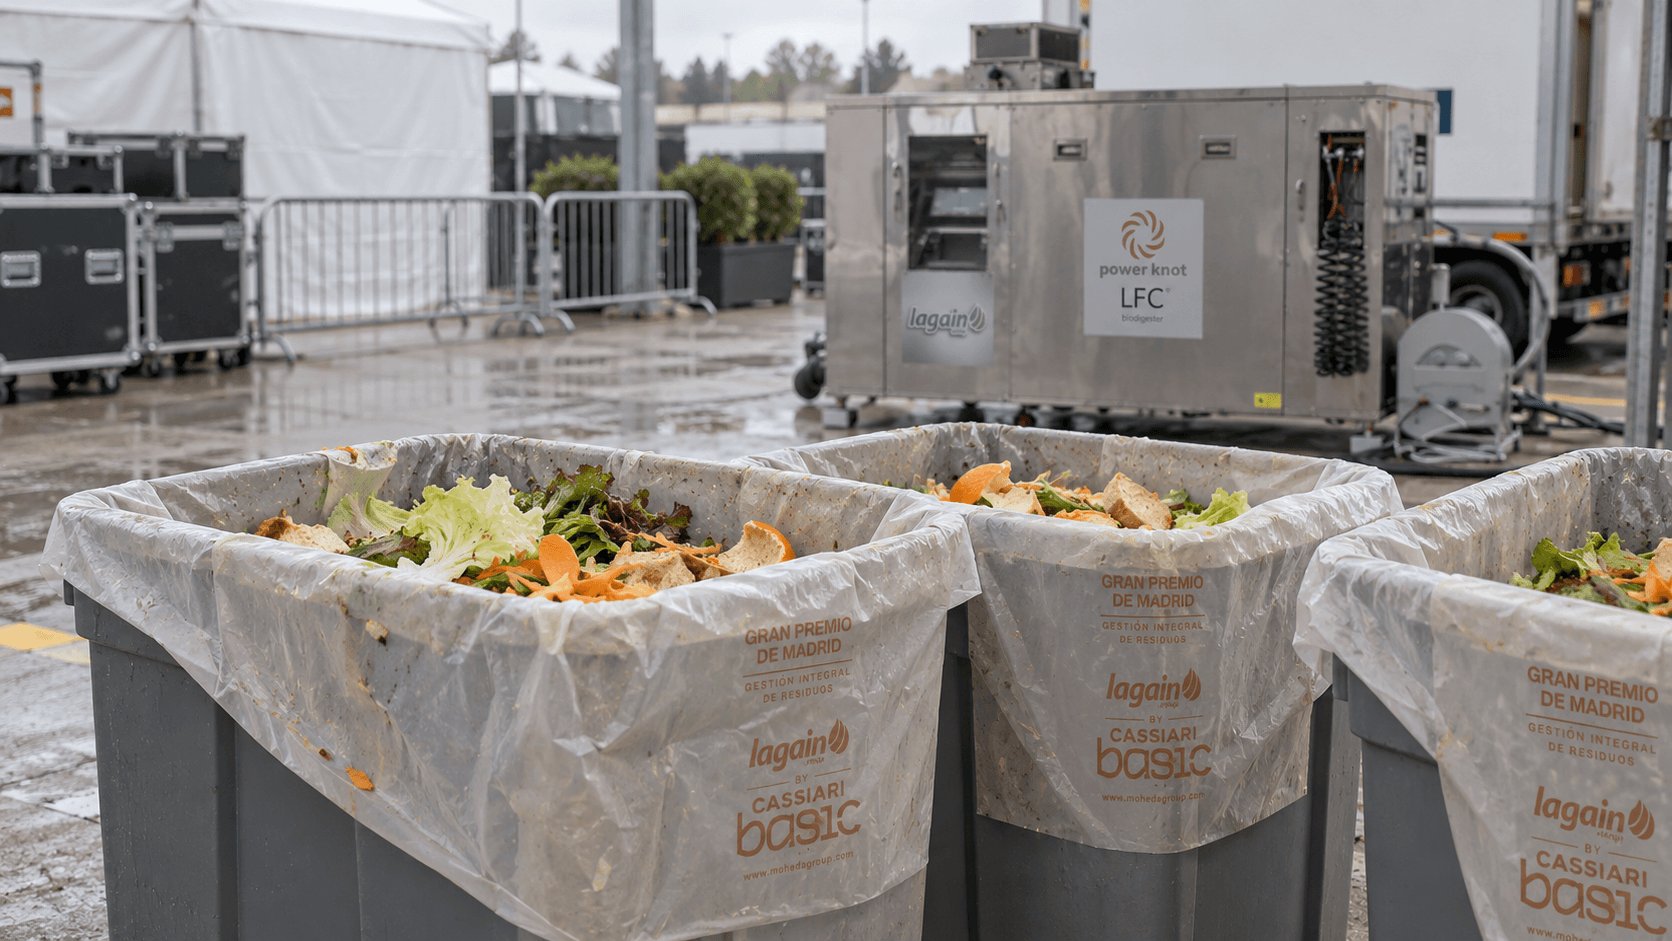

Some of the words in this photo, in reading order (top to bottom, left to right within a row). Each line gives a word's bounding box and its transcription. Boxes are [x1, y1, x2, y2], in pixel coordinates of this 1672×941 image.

[1099, 265, 1148, 278] power
[1151, 262, 1187, 276] knot
[909, 307, 968, 332] lagain
[1121, 314, 1164, 324] biodigester
[1101, 574, 1144, 589] GRAN
[1148, 575, 1204, 590] PREMIO
[1112, 593, 1133, 607] DE
[1137, 594, 1195, 608] MADRID
[745, 625, 790, 645] GRAN
[794, 617, 852, 639] PREMIO
[1102, 620, 1149, 631] GESTIÓN
[1153, 621, 1203, 631] INTEGRAL
[757, 647, 778, 664] DE
[782, 638, 842, 660] MADRID
[1119, 635, 1132, 643] DE
[1136, 635, 1186, 644] RESIDUOS
[744, 675, 794, 692] GESTIÓN
[799, 668, 850, 683] INTEGRAL
[1106, 672, 1180, 708] lagain
[1527, 666, 1579, 690] GRAN
[1584, 675, 1659, 703] PREMIO
[763, 693, 777, 703] DE
[781, 684, 833, 700] RESIDUOS
[1149, 715, 1163, 723] BY
[1540, 690, 1565, 710] DE
[1570, 695, 1645, 723] MADRID
[1110, 726, 1197, 743] CASSIARI
[1528, 722, 1585, 741] GESTIÓN
[1591, 734, 1656, 754] INTEGRAL
[749, 729, 827, 772] lagain
[1097, 737, 1212, 780] basic
[1548, 741, 1564, 753] DE
[1569, 745, 1635, 766] RESIDUOS
[795, 774, 808, 784] BY
[752, 780, 844, 814] CASSIARI
[1533, 785, 1625, 833] lagain
[737, 799, 861, 857] basic
[1585, 843, 1601, 855] BY
[743, 851, 854, 881] www.mohedagroup.com
[1536, 850, 1647, 888] CASSIARI
[1520, 858, 1668, 935] basic
